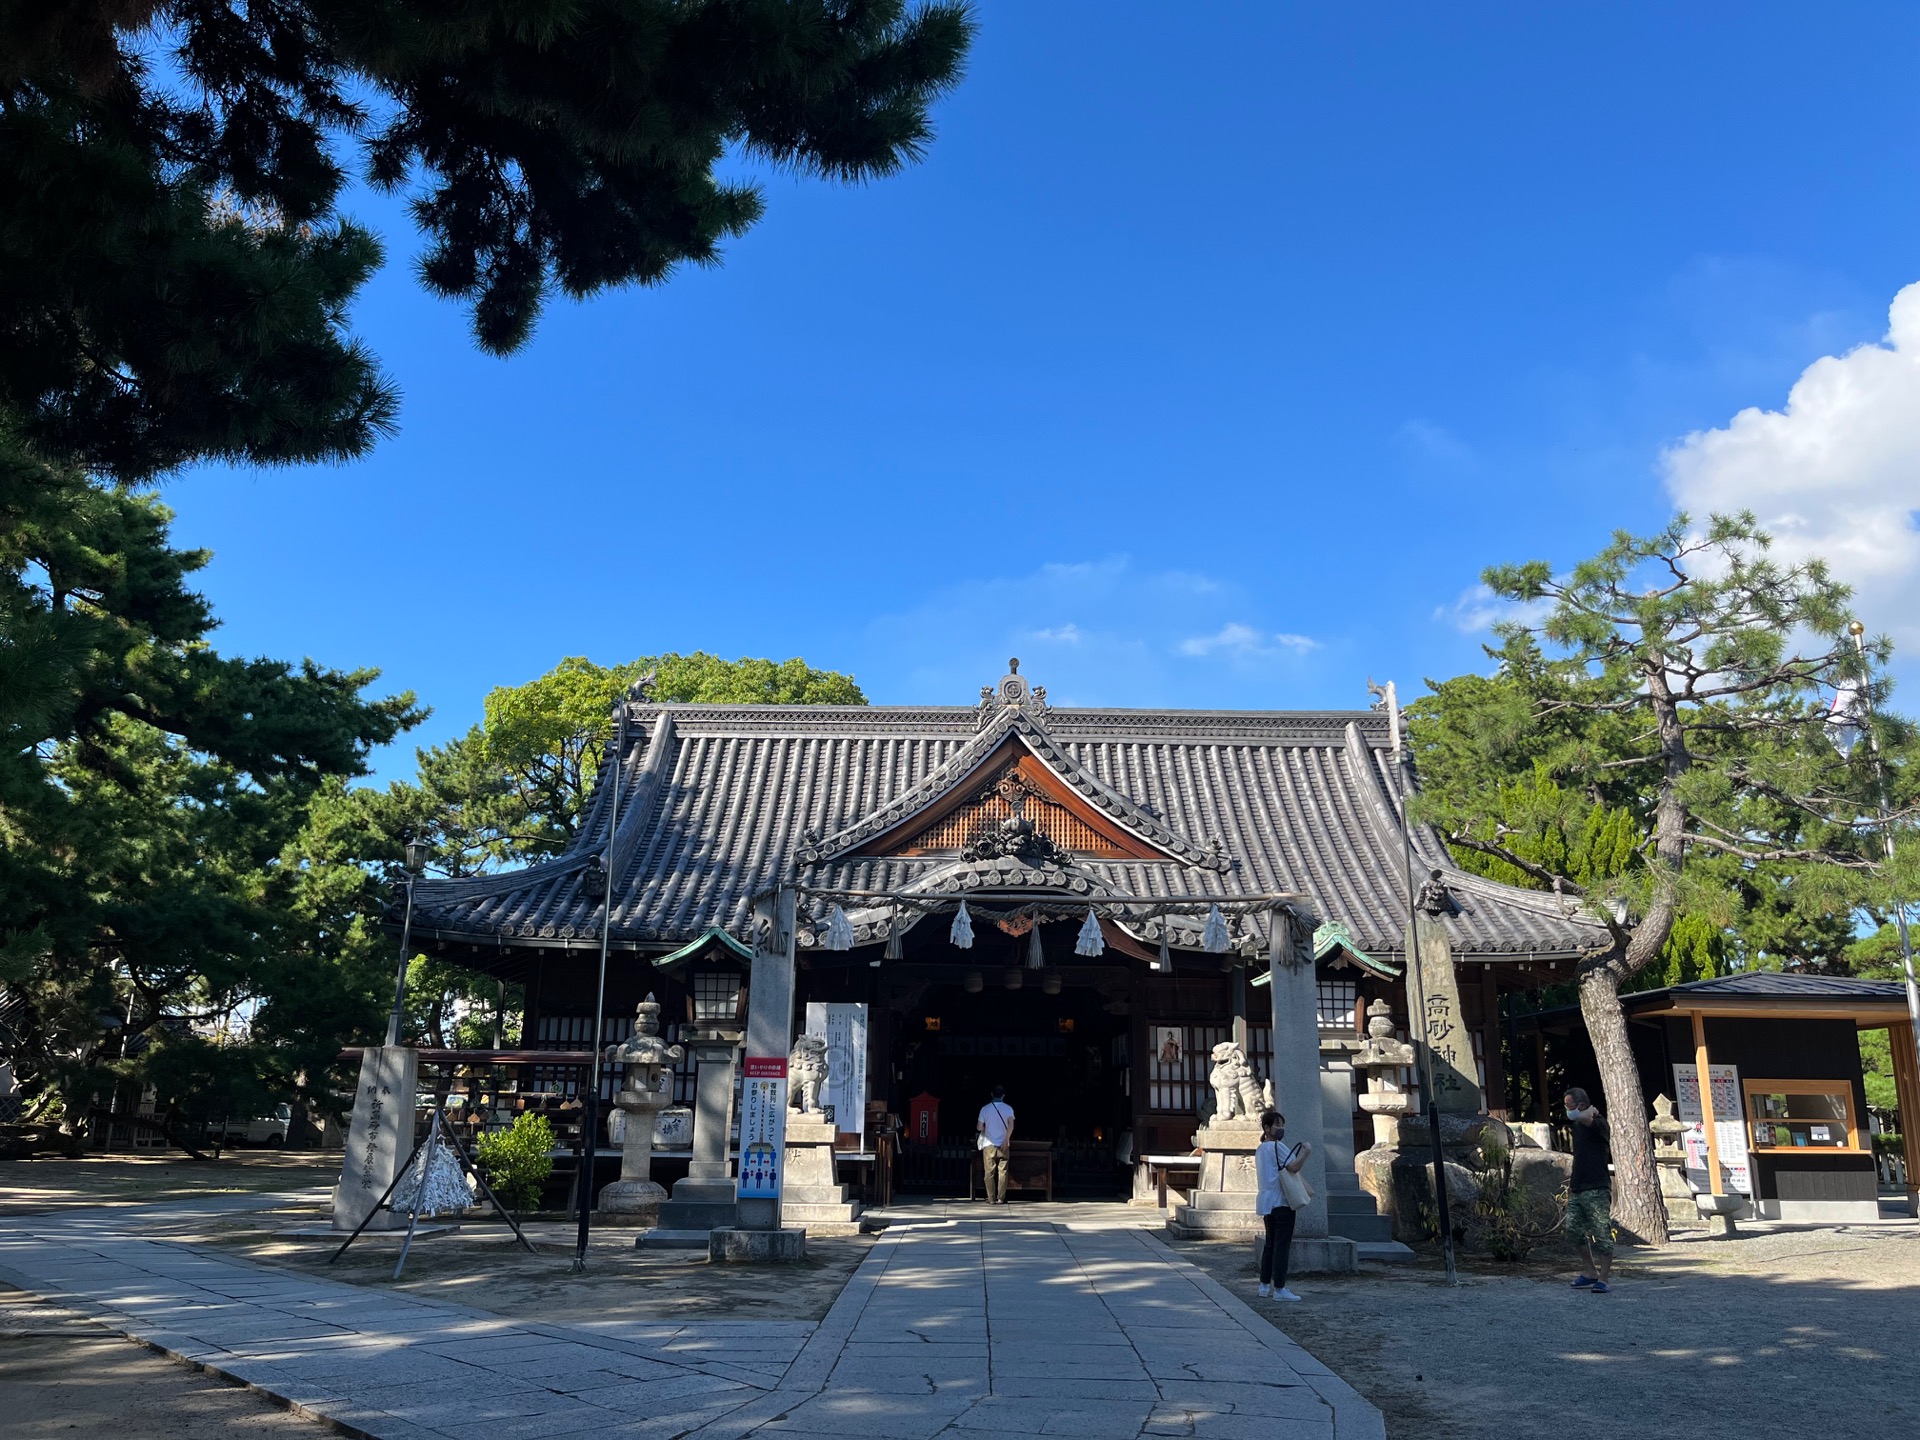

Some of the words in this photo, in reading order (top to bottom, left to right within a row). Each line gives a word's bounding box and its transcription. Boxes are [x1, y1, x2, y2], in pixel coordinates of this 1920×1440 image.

[1427, 993, 1462, 1095] 高砂神社
[748, 1082, 758, 1141] お参りしましょう
[768, 1082, 778, 1141] 複数列に広がって
